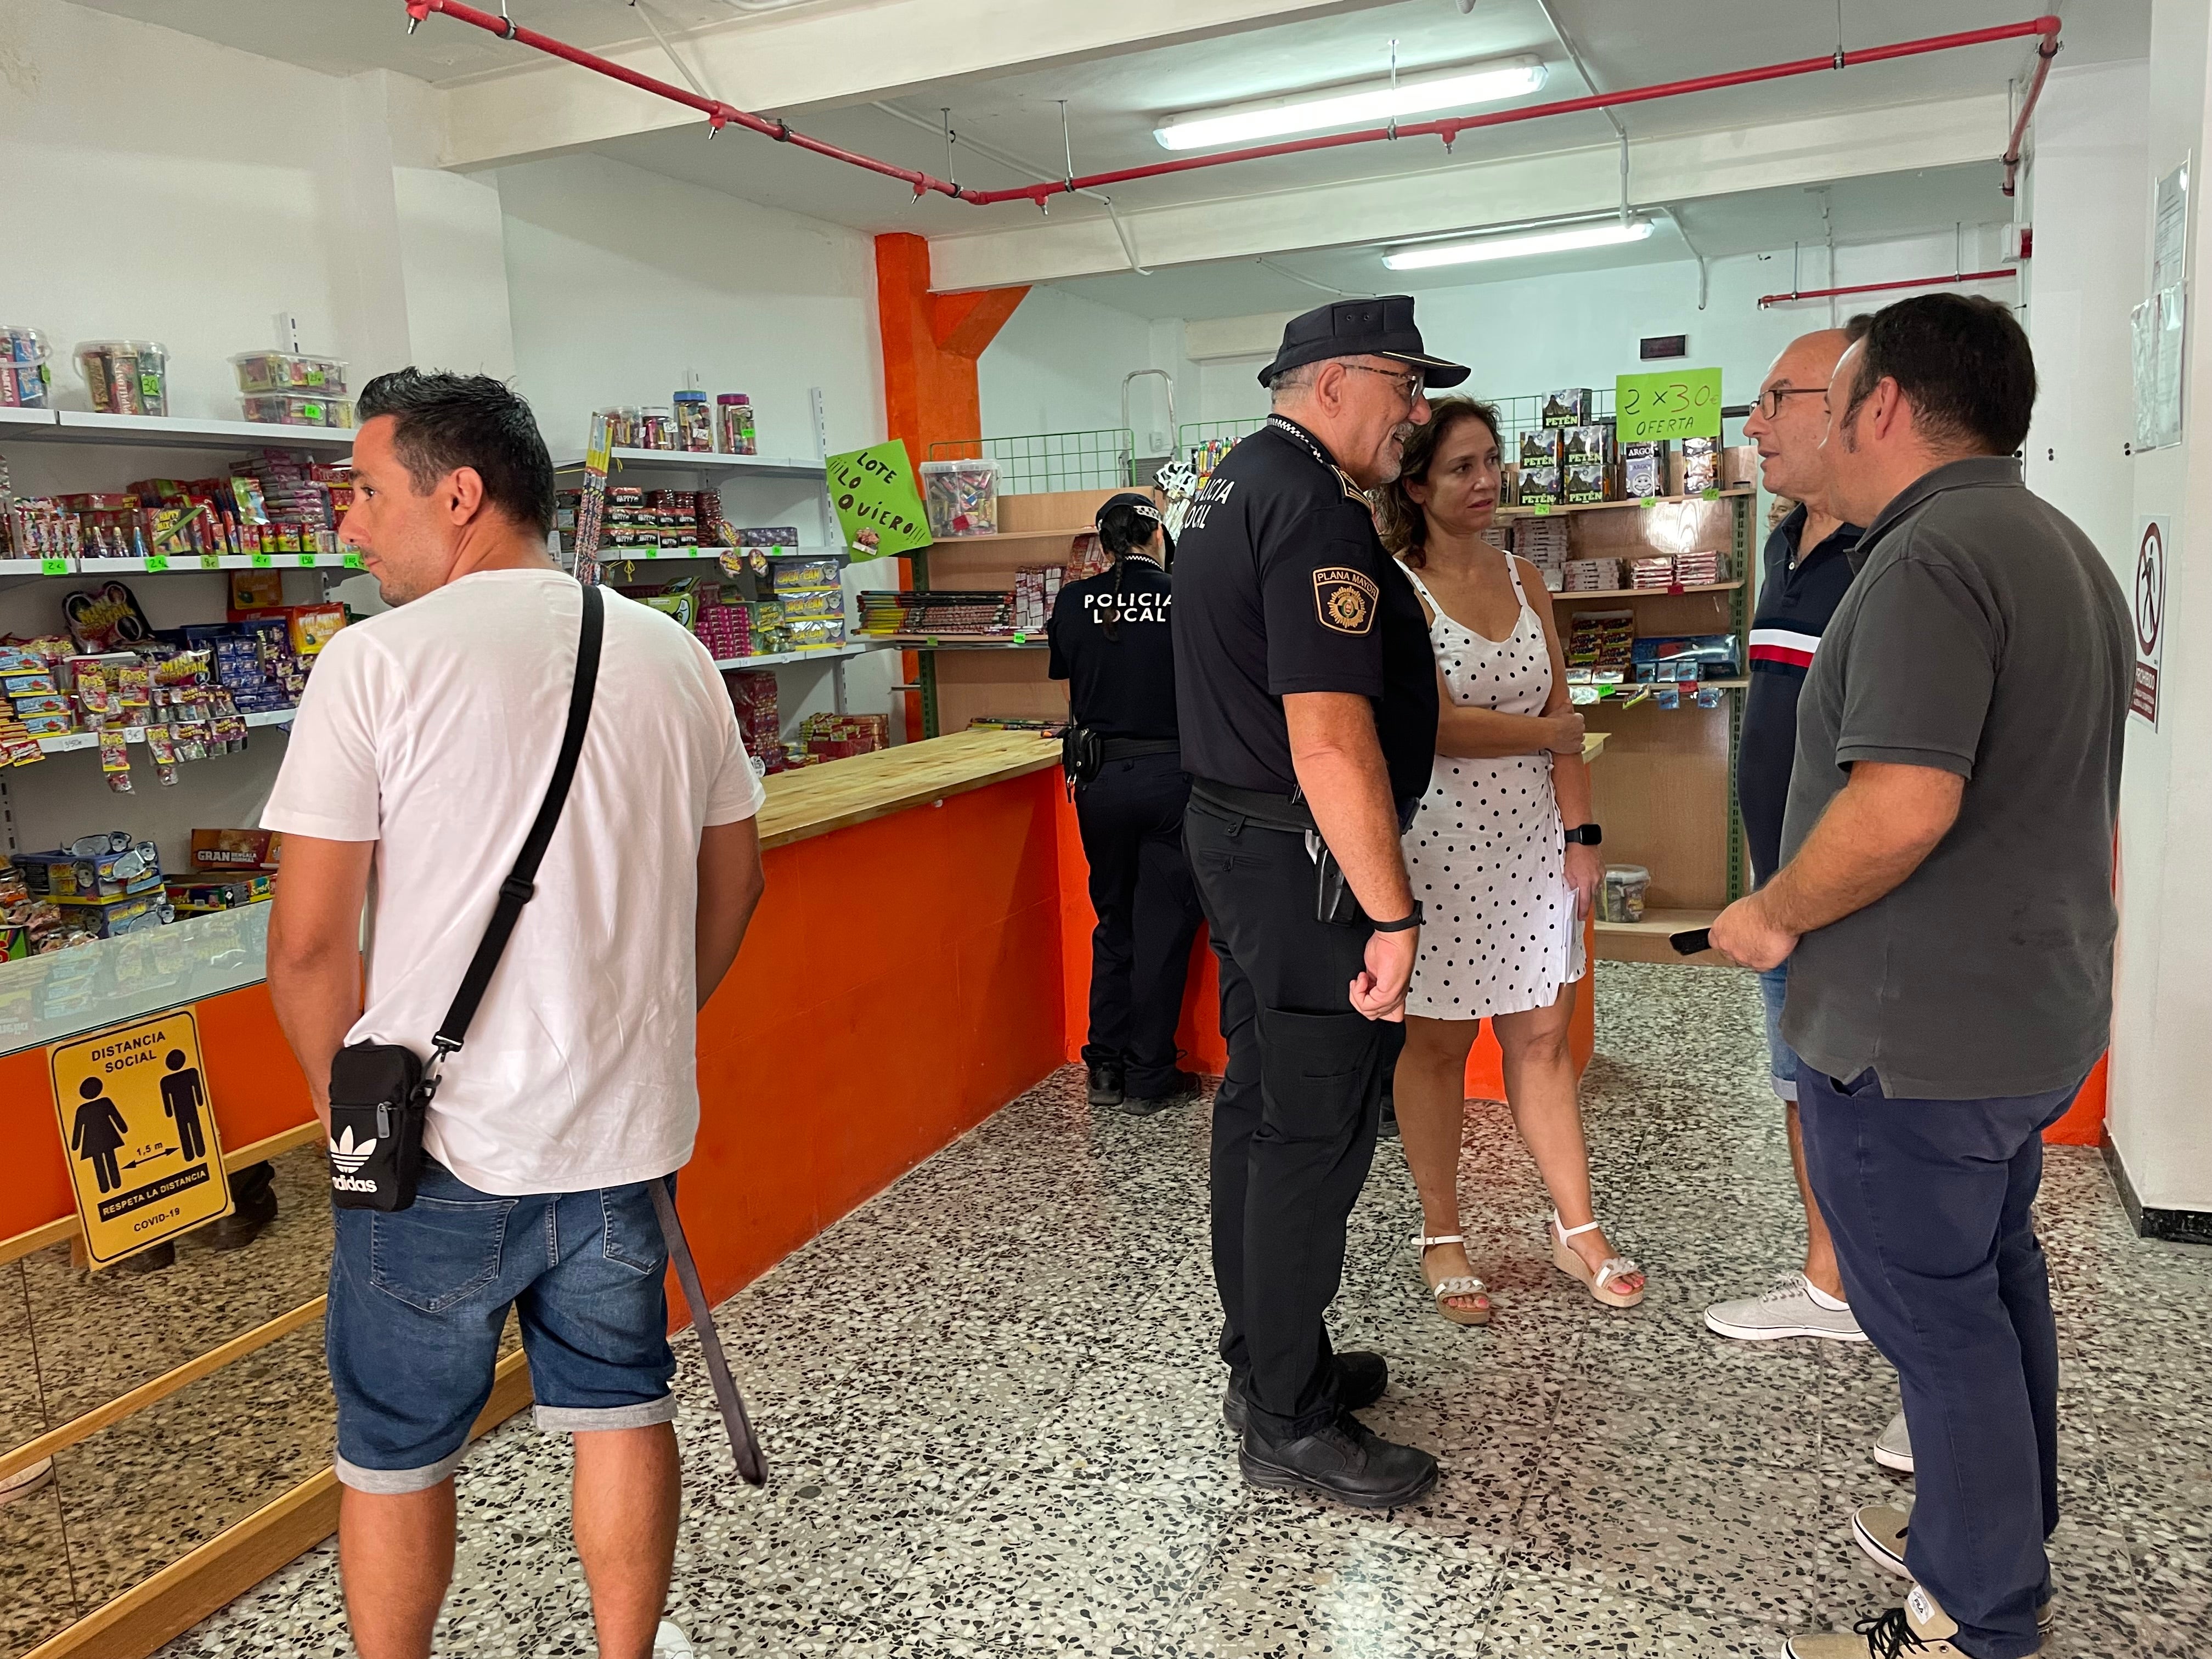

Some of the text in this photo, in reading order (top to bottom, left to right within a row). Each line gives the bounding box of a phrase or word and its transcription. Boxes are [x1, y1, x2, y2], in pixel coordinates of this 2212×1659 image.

[1624, 389, 1640, 415] 2
[1546, 414, 1578, 426] PETÉN
[1637, 416, 1694, 436] OFERTA
[856, 452, 897, 484] LOTE
[1184, 504, 1211, 529] OCAL
[1317, 571, 1376, 597] PLANA MAYOR
[1084, 593, 1172, 608] POLICIA
[198, 850, 230, 861] GRAN
[91, 1030, 166, 1062] DISTANCIA
[104, 1049, 156, 1074] SOCIAL
[137, 1142, 163, 1157] 1,5 m
[102, 1170, 207, 1216] RESPETA LA DISTANCIA
[133, 1207, 180, 1232] COVID-19
